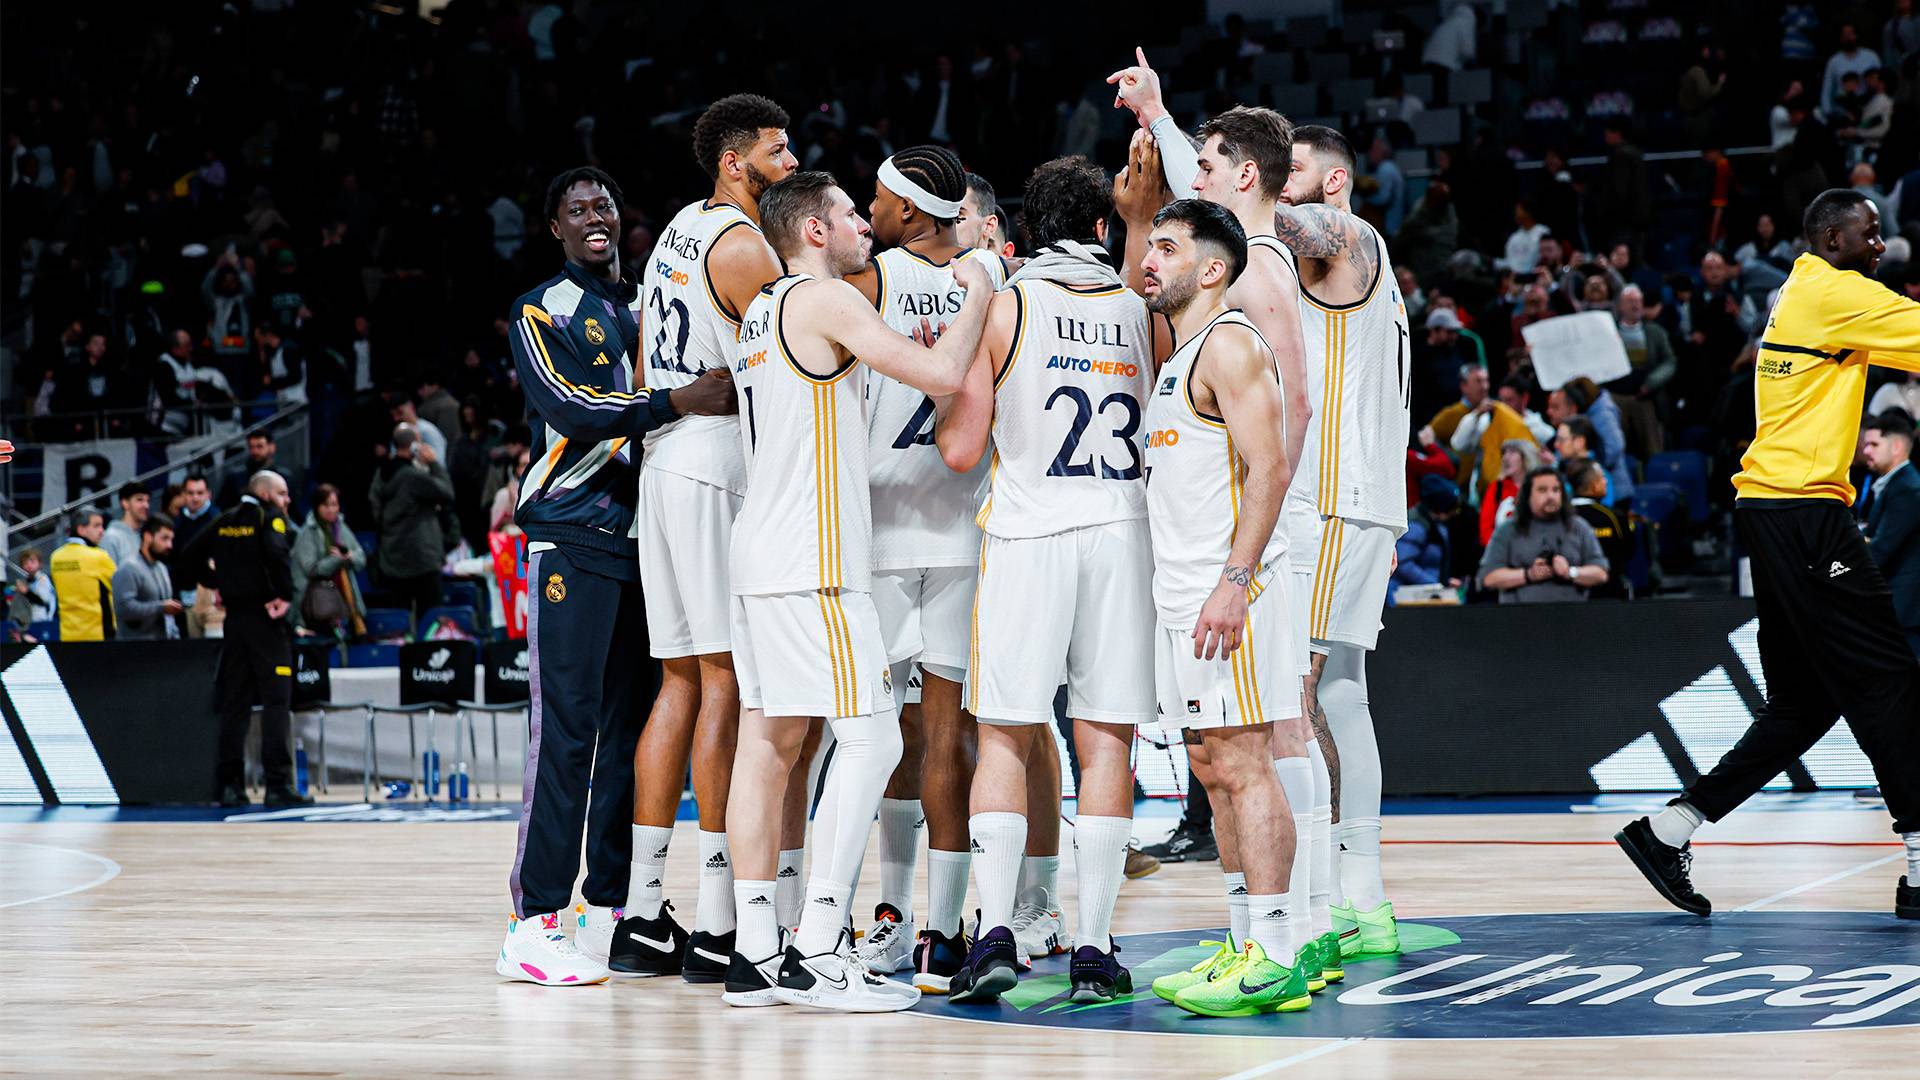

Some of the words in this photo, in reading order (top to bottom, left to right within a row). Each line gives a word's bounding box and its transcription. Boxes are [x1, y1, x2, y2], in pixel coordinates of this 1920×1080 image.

[1055, 316, 1129, 347] LLULL
[1046, 355, 1138, 378] AUTOHERO
[1044, 385, 1143, 481] 23
[1336, 951, 1920, 1026] Unicaj
